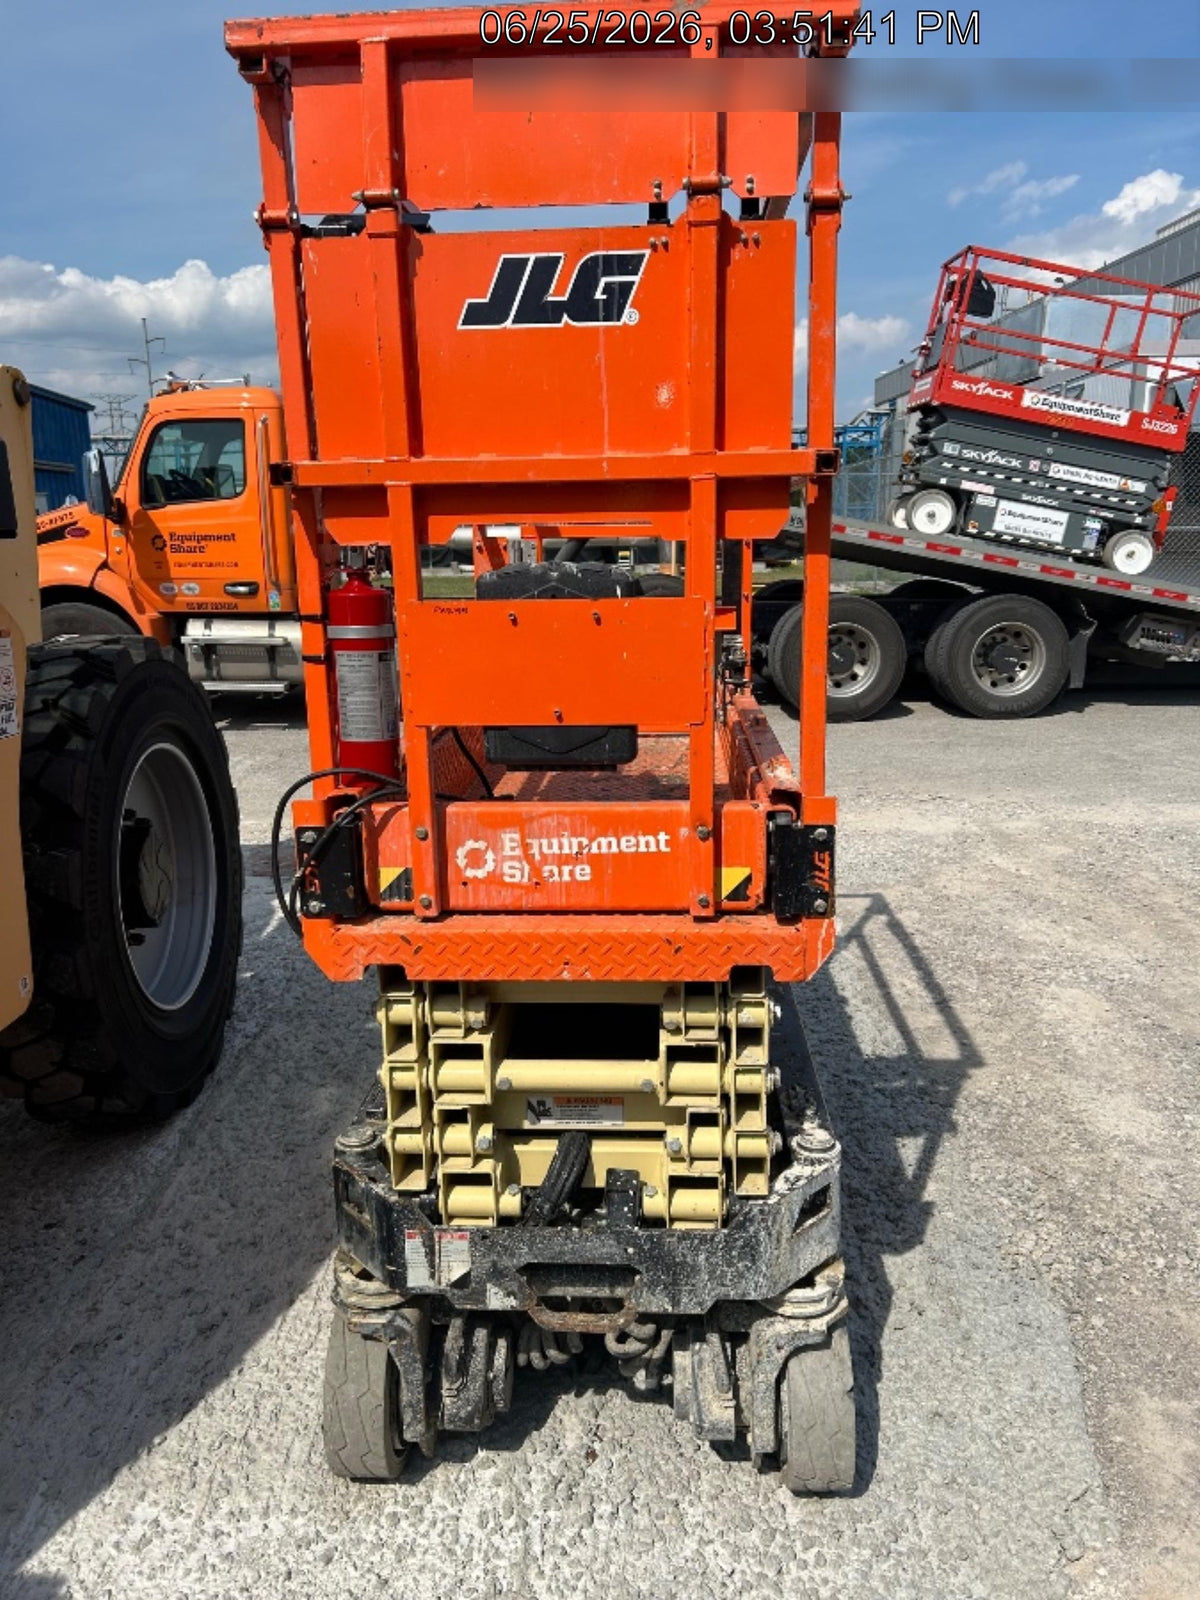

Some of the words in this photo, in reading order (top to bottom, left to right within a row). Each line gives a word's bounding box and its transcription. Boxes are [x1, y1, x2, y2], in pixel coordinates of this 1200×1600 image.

[951, 380, 1014, 400] SKYJACK
[961, 449, 1022, 468] SKYJACK
[169, 531, 236, 544] Equipment
[170, 543, 206, 554] Share
[814, 850, 830, 892] JLG
